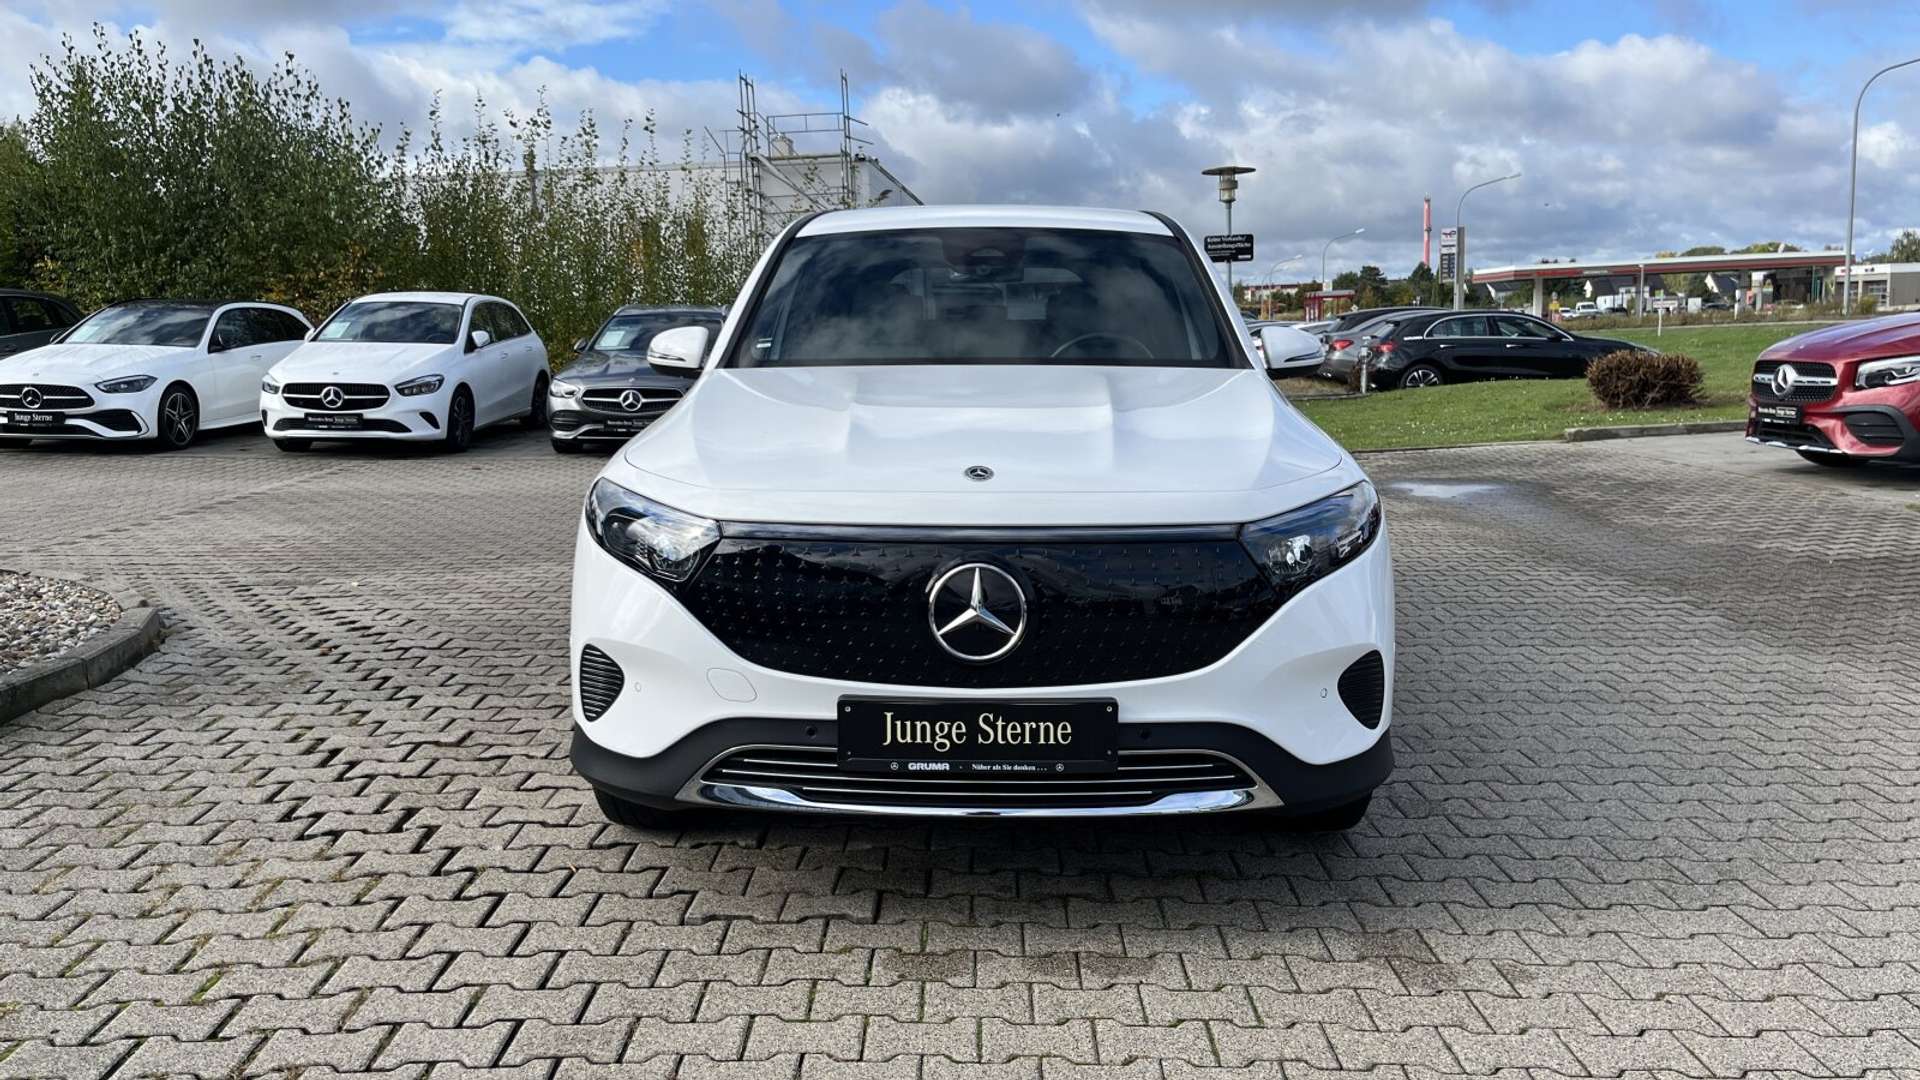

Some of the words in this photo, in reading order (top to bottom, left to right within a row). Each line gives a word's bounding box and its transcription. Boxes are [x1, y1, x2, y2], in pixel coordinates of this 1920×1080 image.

[883, 711, 967, 752] Junge
[977, 712, 1072, 745] Sterne
[907, 762, 950, 771] GRUMA
